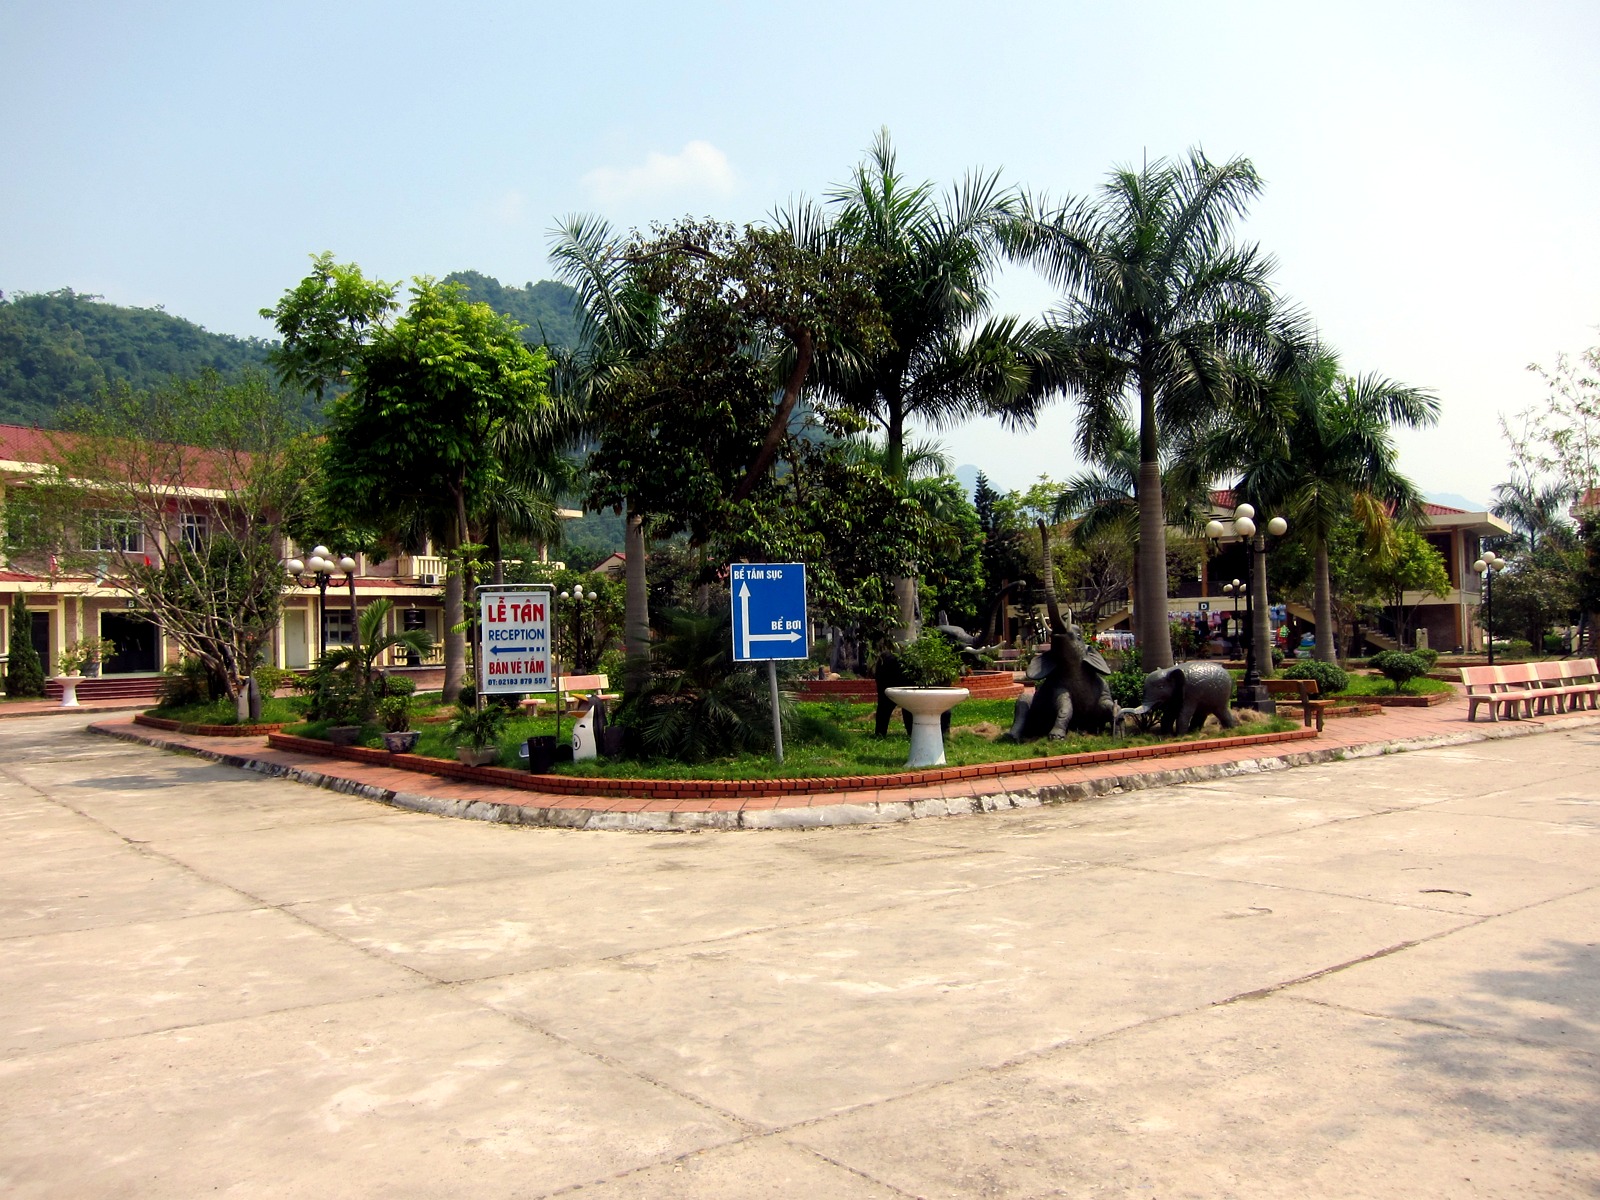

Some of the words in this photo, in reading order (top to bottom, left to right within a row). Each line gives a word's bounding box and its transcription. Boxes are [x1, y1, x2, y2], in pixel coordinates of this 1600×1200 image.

[734, 566, 745, 579] BỂ
[766, 570, 783, 581] SỤC
[128, 600, 135, 608] B
[488, 596, 507, 623] LỄ
[510, 599, 544, 624] TÂN
[771, 616, 784, 630] BỂ
[786, 620, 802, 630] BƠI
[488, 629, 545, 641] RECEPTION
[489, 658, 509, 675] BÁN
[510, 657, 522, 674] VÉ
[524, 655, 544, 673] TẮM
